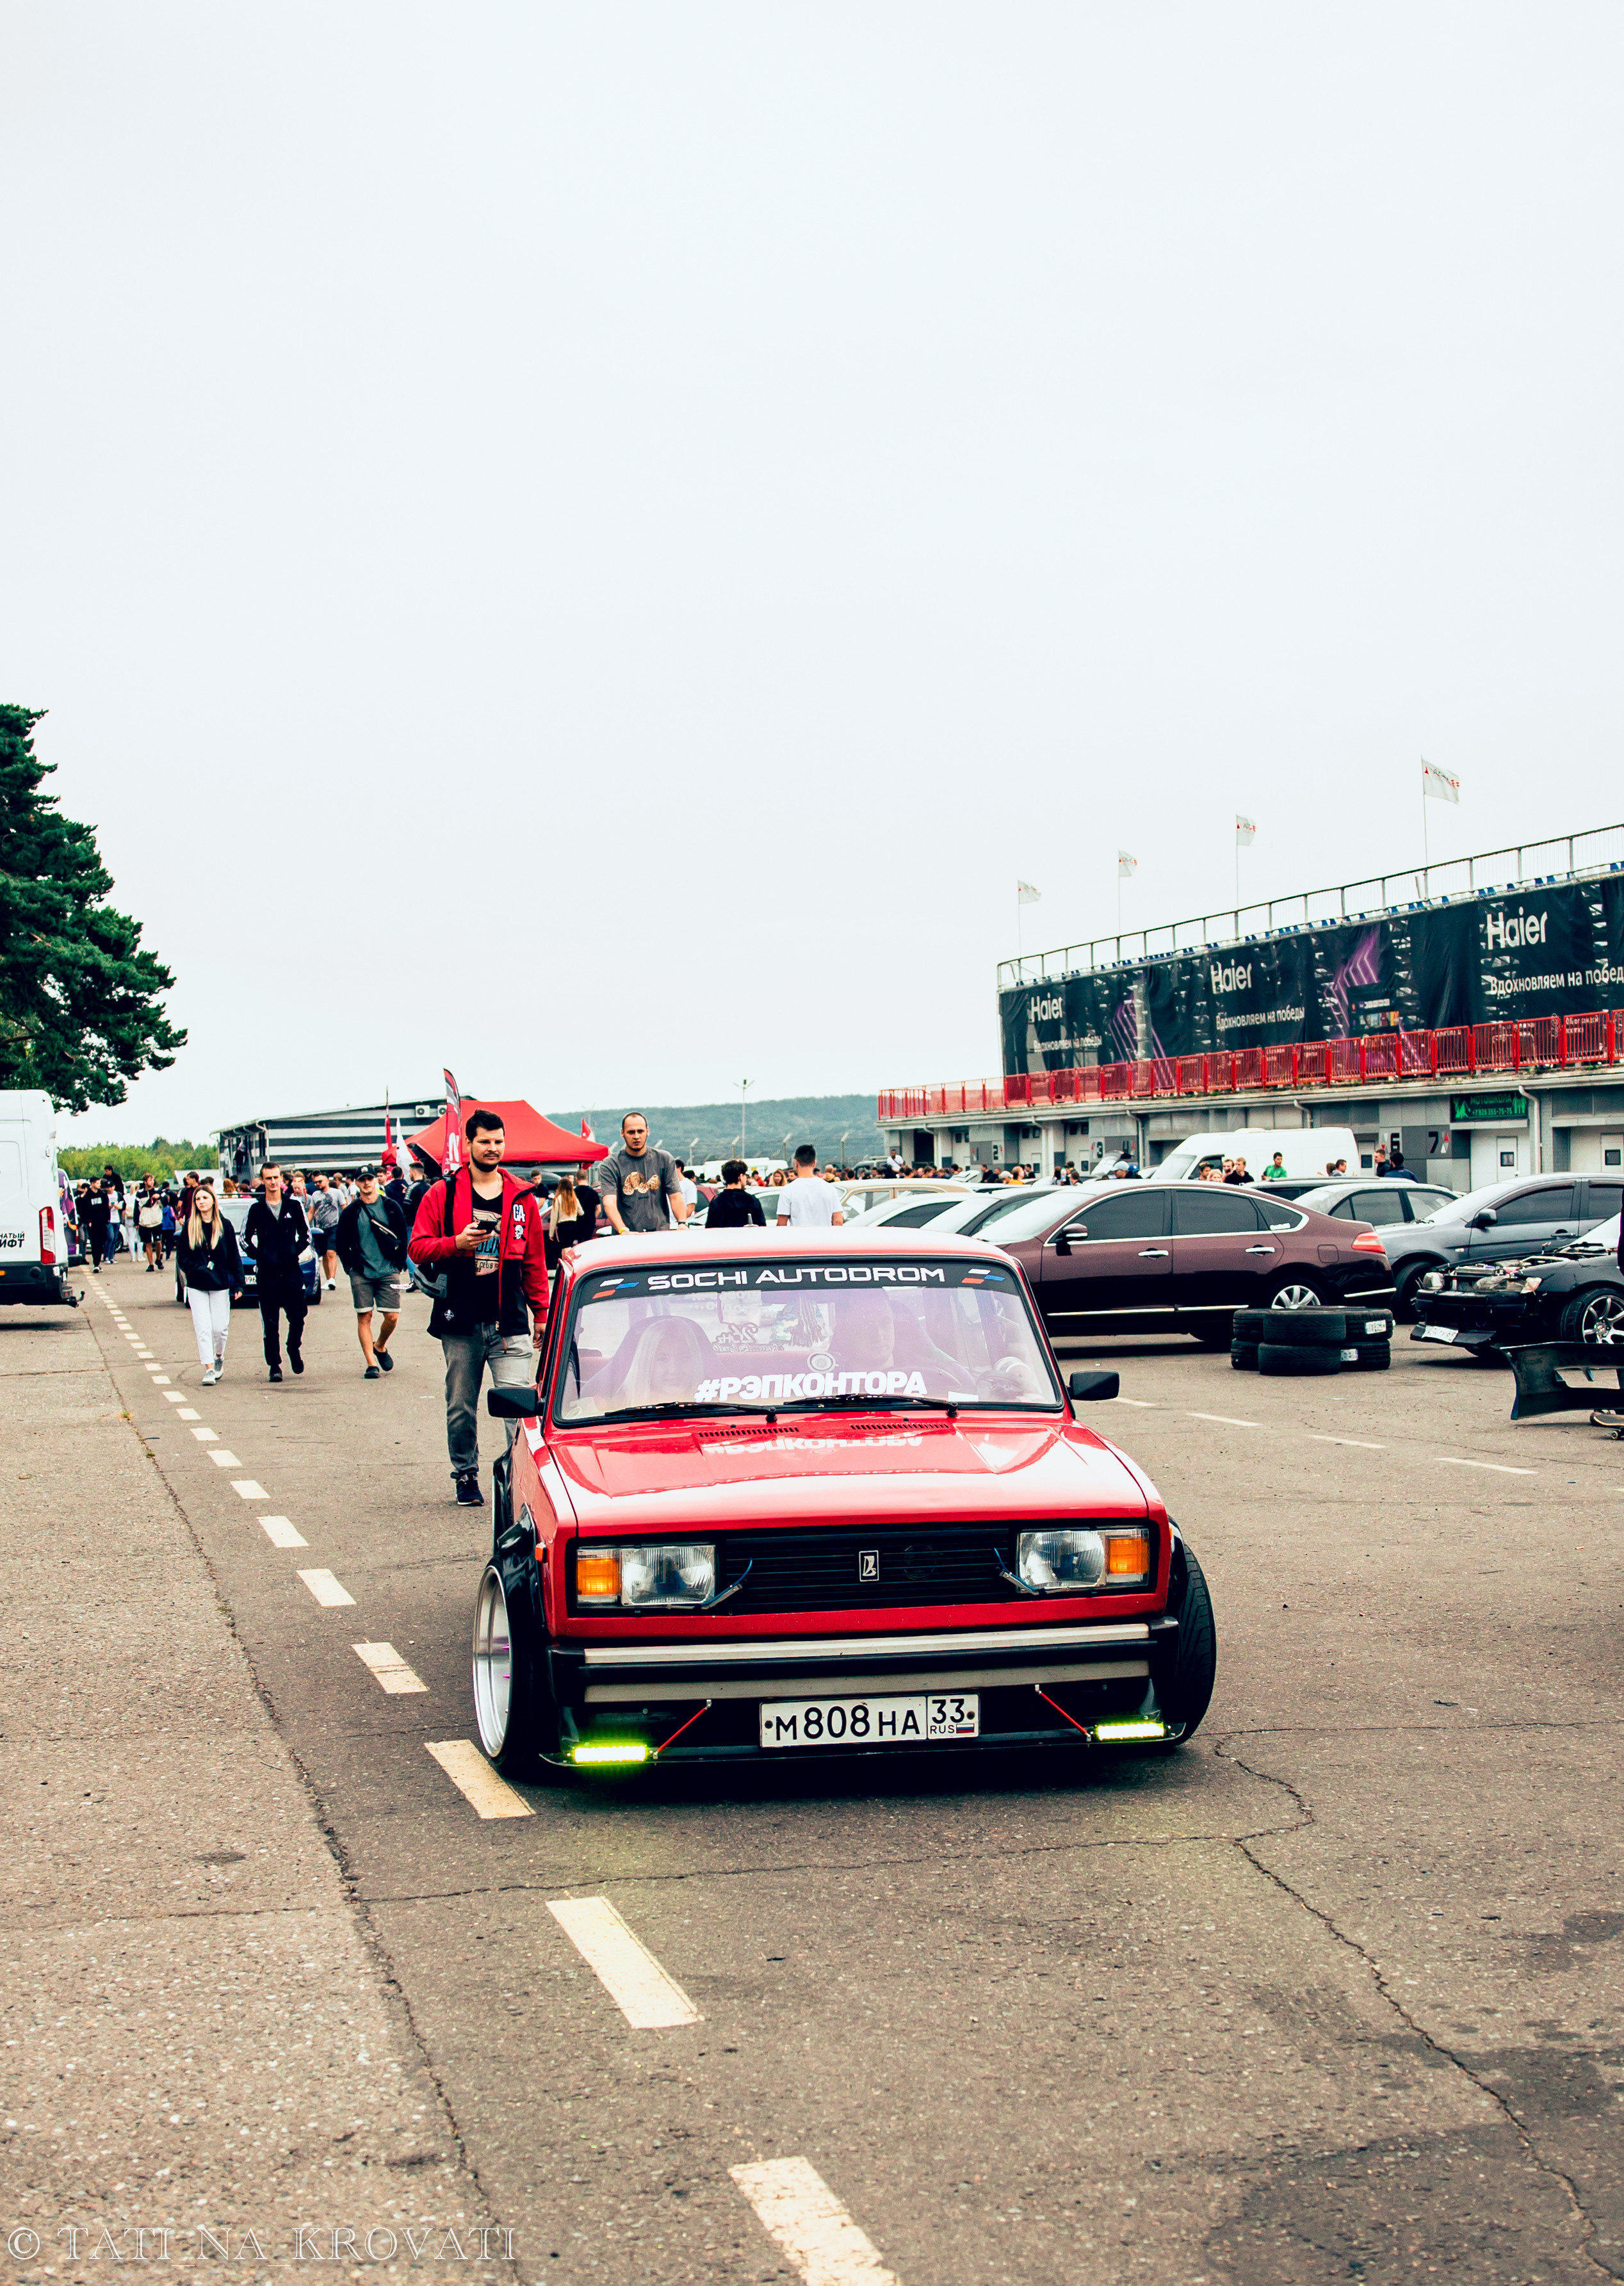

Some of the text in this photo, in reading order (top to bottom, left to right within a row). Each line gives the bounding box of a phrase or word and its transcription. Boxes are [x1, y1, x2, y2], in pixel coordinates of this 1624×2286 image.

[1486, 906, 1548, 950] Haier
[1210, 958, 1252, 994] Haier
[1490, 973, 1565, 1000] Вдохновляем
[1568, 971, 1583, 987] на
[1030, 991, 1063, 1023] Haier
[1216, 1004, 1305, 1032] Вдохновляем на победы
[993, 1145, 998, 1160] 2
[1096, 1142, 1103, 1158] 3
[1390, 1133, 1400, 1151] 6
[1428, 1131, 1439, 1153] 7
[647, 1267, 945, 1290] SOCHI AUTODROM
[694, 1371, 928, 1403] #РЭПКОНТОРА
[931, 1698, 965, 1724] 33
[930, 1725, 955, 1734] RUS
